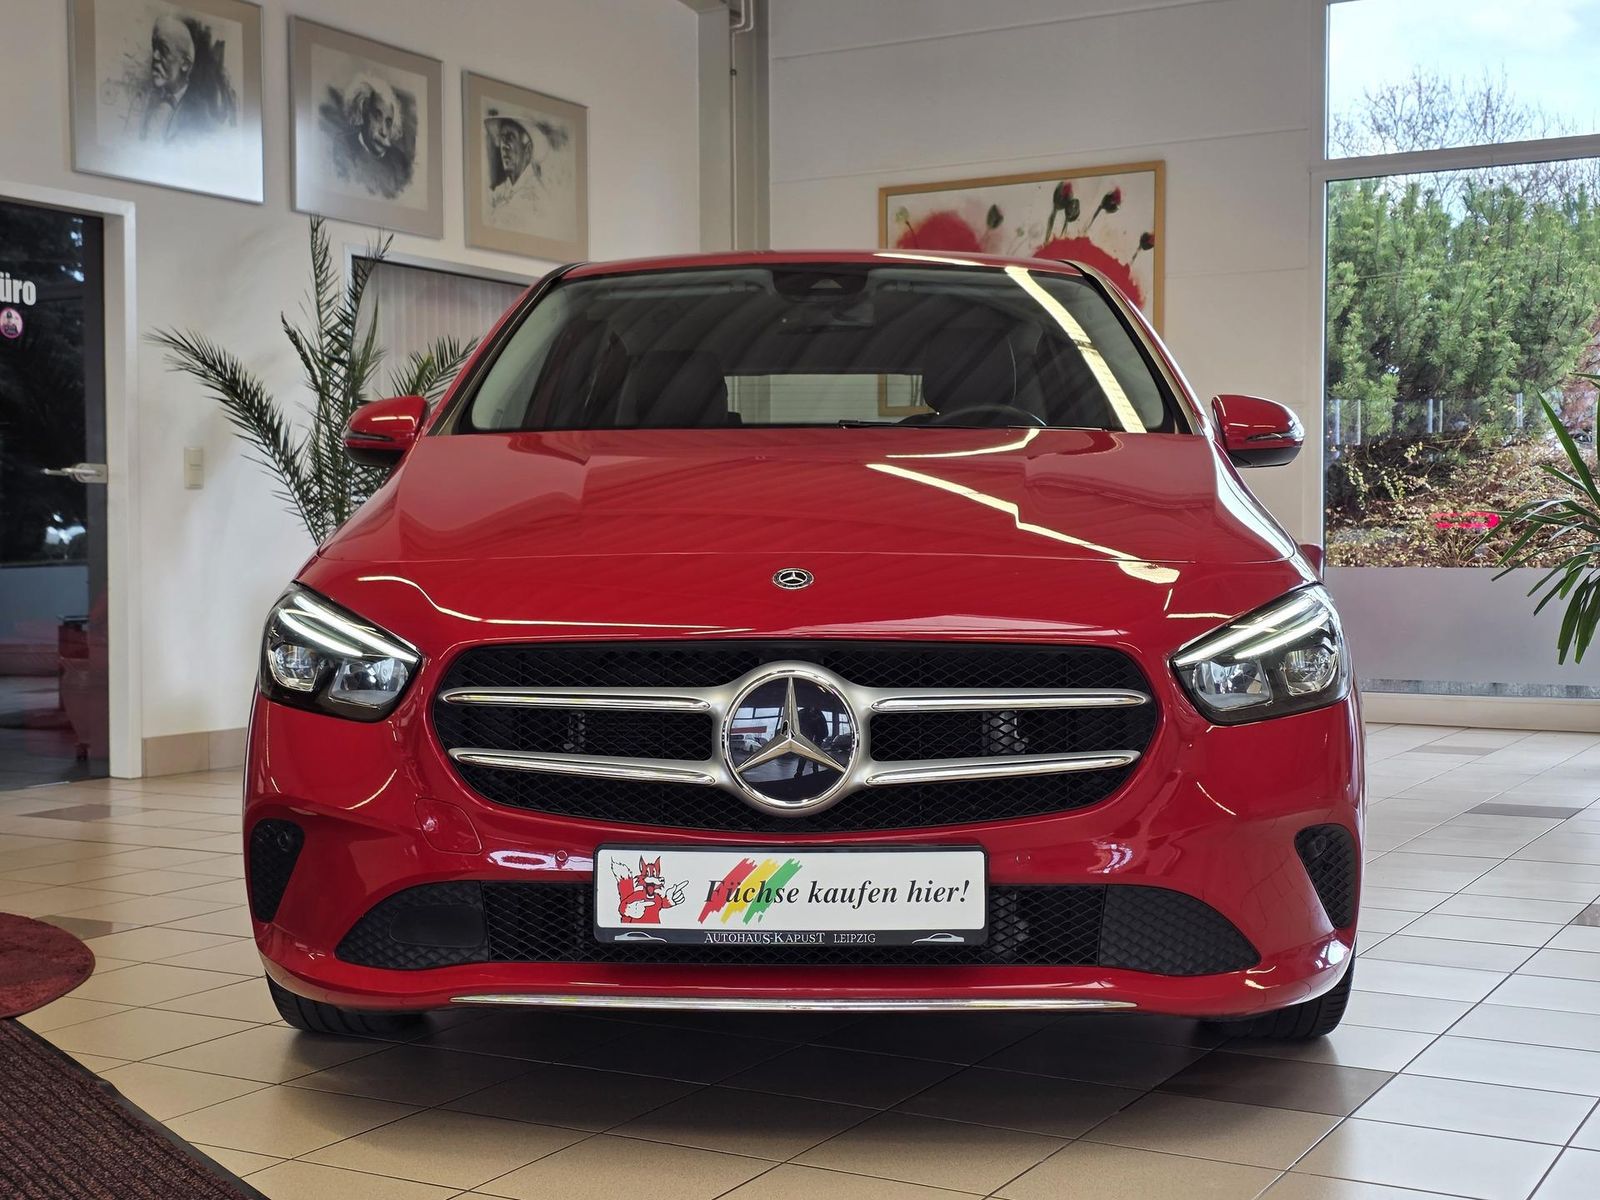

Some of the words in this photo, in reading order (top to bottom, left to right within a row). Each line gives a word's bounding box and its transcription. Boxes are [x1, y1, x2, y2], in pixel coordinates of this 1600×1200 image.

[704, 880, 800, 904] Füchse
[807, 880, 898, 910] kaufen
[906, 879, 970, 903] hier!
[833, 933, 877, 944] LEIPZIG
